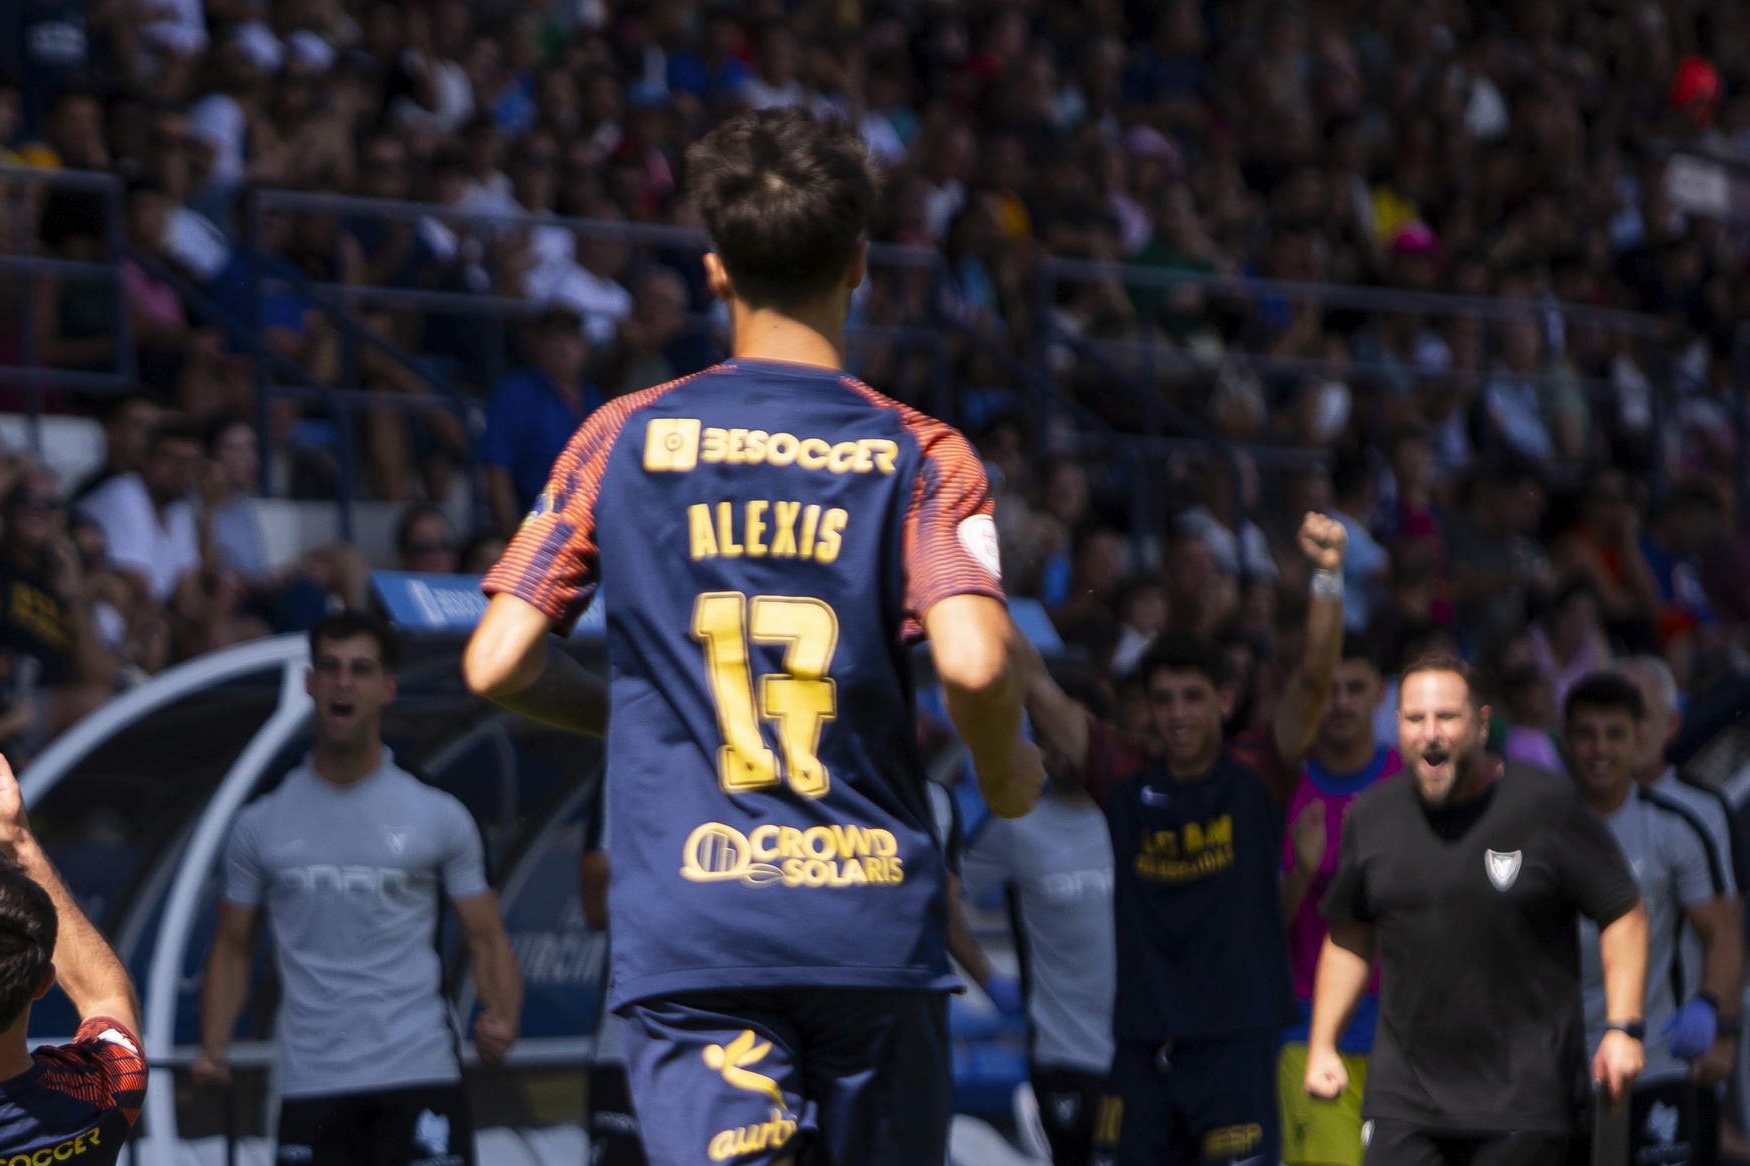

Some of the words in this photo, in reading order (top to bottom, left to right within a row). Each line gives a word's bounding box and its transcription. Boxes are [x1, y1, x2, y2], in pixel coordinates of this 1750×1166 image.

[701, 427, 899, 475] BESOCCER
[687, 500, 849, 563] ALEXIS
[689, 588, 840, 800] 17
[747, 824, 899, 862] CROWD
[781, 856, 905, 888] SOLARIS
